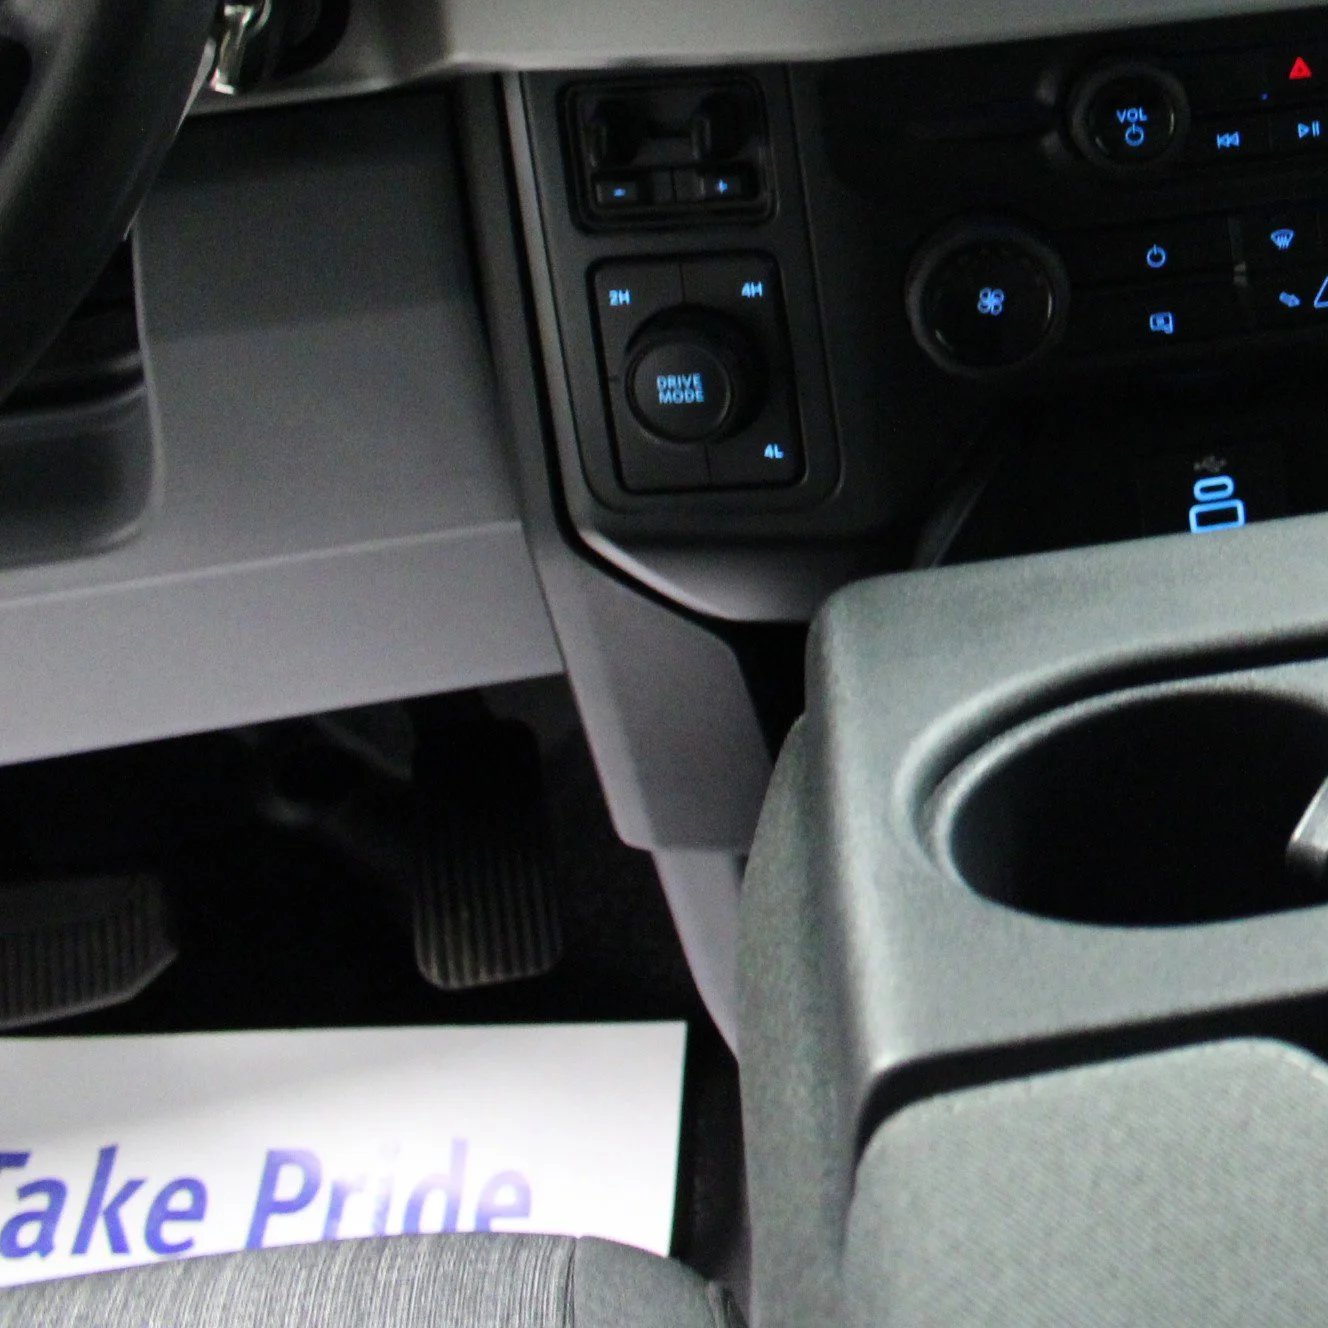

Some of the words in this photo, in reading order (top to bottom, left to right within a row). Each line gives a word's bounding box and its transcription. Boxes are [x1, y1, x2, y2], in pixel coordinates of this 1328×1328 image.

[1116, 107, 1148, 123] VOL
[609, 289, 631, 306] 2H
[741, 280, 763, 299] 4H
[656, 373, 703, 390] DRIVE
[659, 388, 704, 404] MODE
[764, 443, 785, 460] 4L
